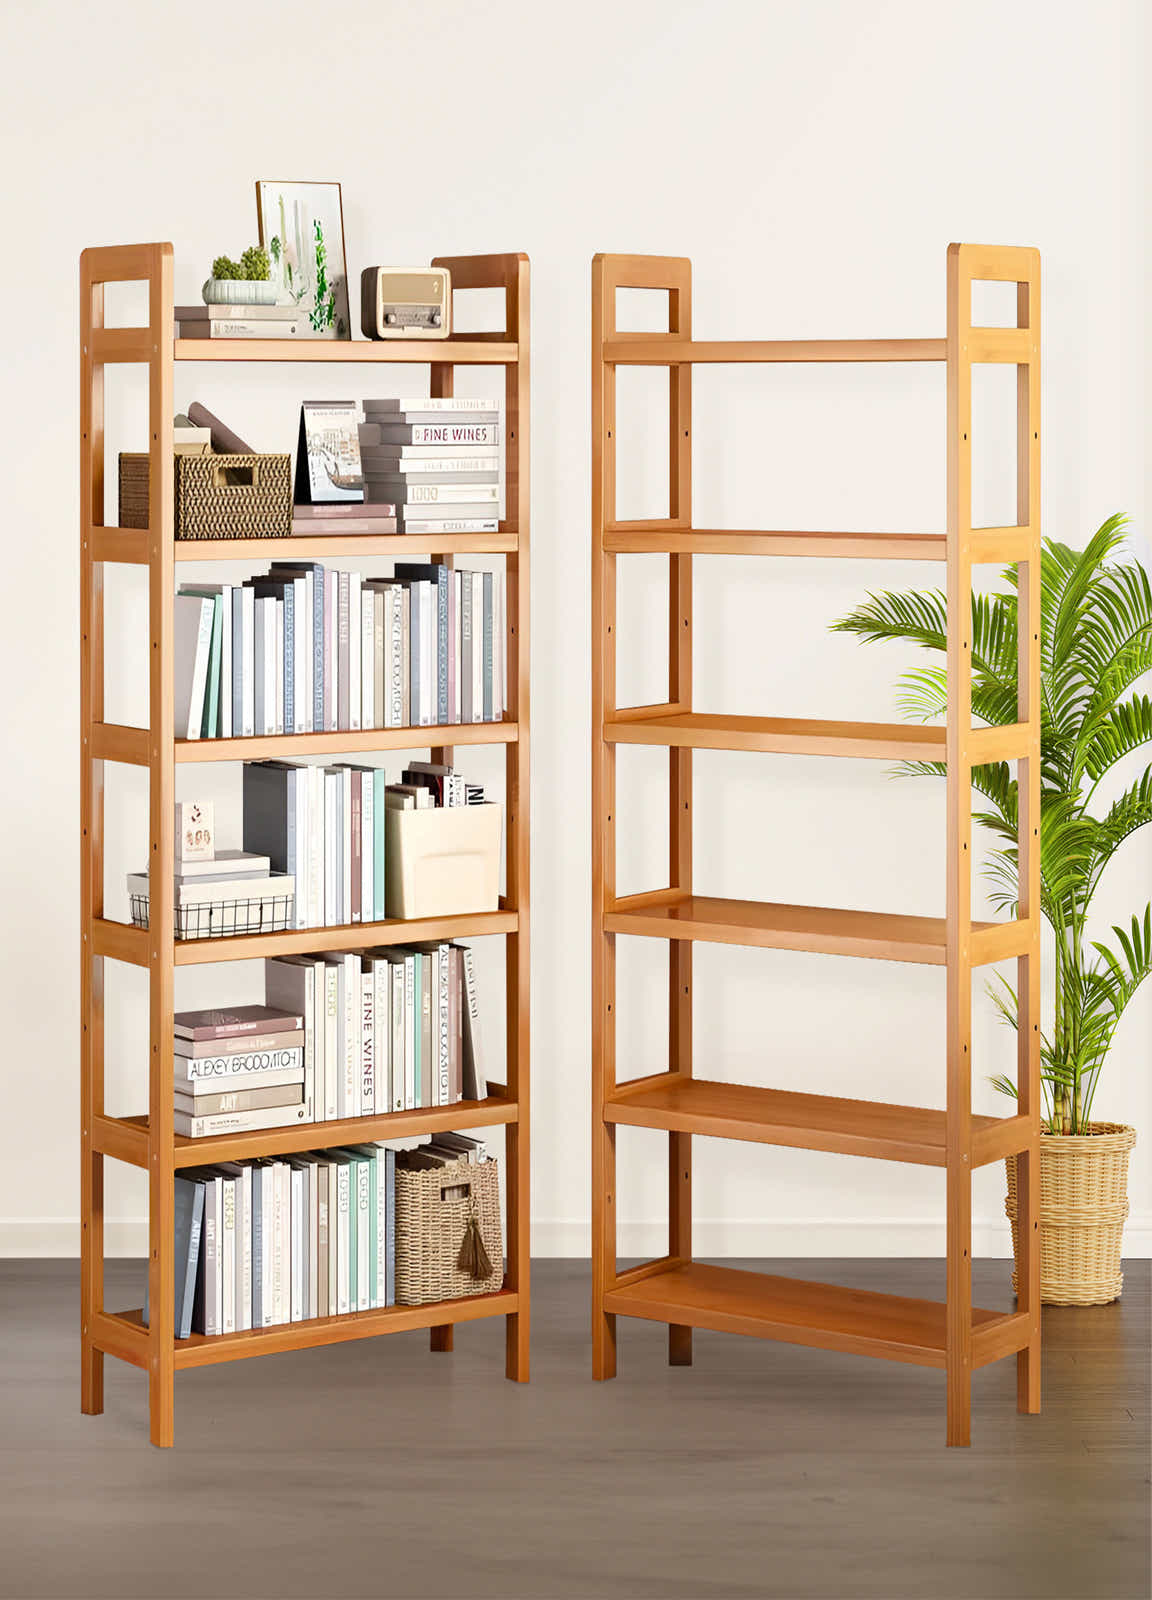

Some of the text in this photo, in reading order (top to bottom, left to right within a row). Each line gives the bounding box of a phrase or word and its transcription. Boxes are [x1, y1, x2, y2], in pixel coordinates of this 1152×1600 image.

[424, 428, 487, 441] FINE WINES
[363, 992, 373, 1096] FINE WINES
